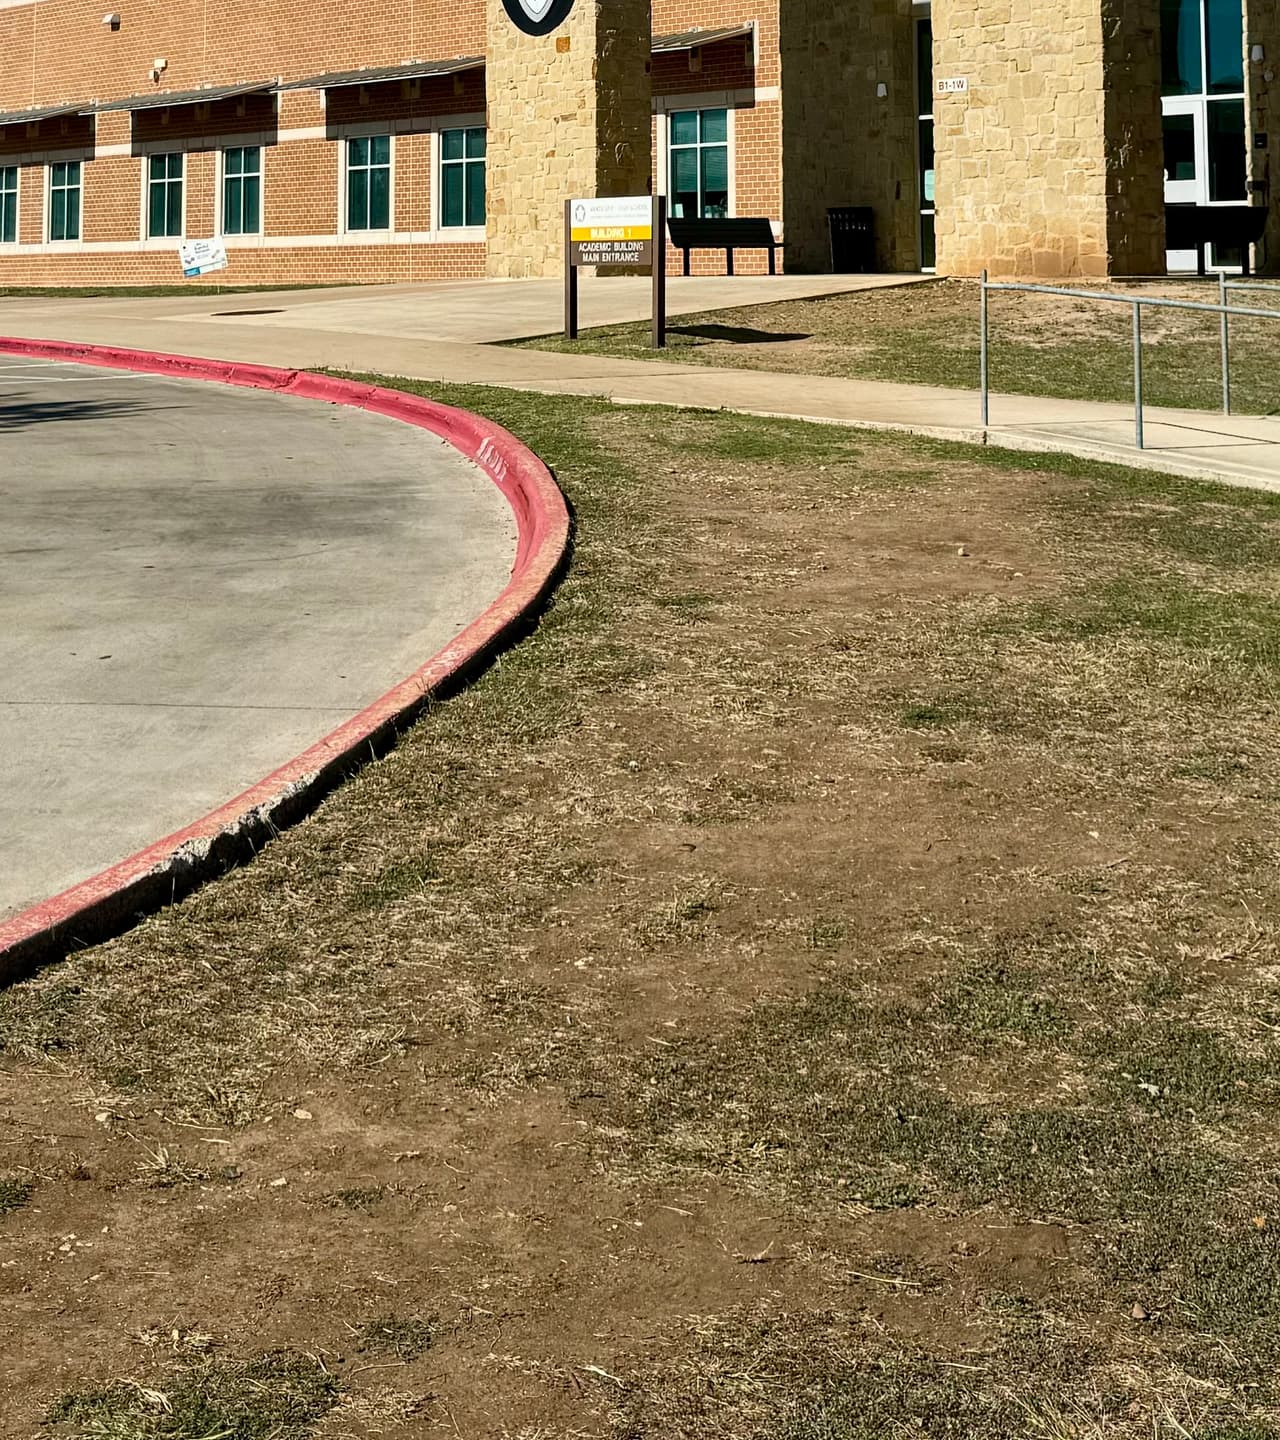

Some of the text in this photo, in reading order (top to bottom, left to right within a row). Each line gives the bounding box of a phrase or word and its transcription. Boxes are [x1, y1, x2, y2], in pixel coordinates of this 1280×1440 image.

[938, 80, 964, 91] B1-1W
[590, 227, 632, 240] BUILDING 1
[578, 241, 644, 252] ACADEMIC BUILDING
[582, 252, 640, 262] MAIN ENTRANCE
